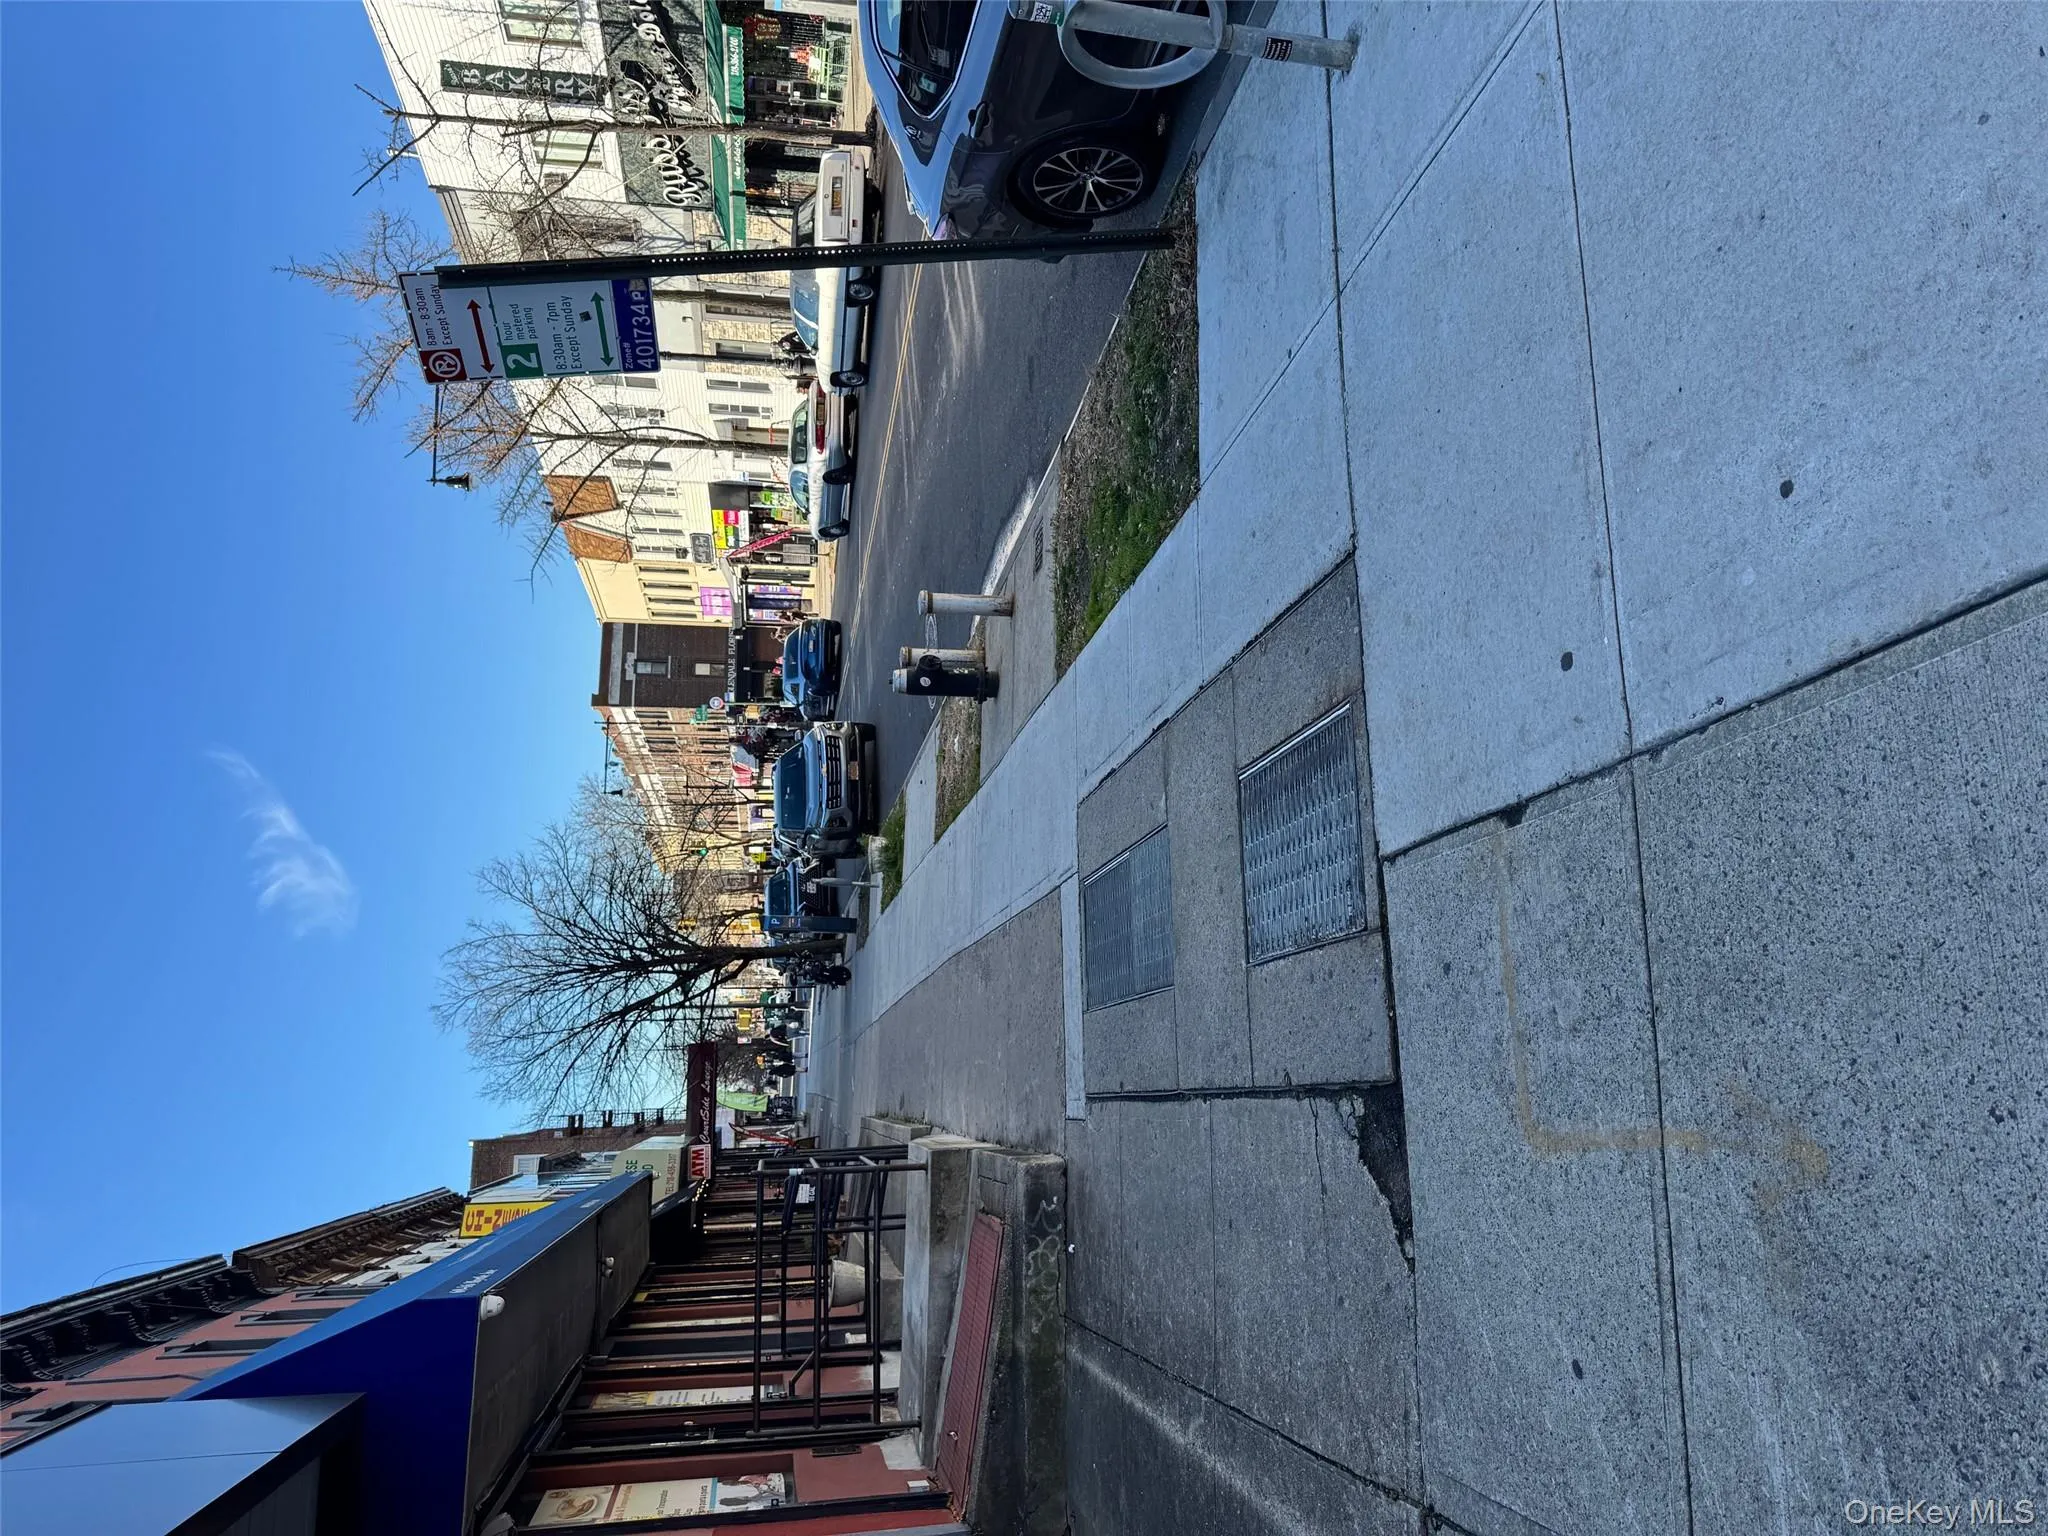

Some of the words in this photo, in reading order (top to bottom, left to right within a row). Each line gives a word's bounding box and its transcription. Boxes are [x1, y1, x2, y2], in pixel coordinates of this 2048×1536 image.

[463, 68, 597, 97] BAKERY
[430, 284, 446, 315] Sunday
[546, 302, 560, 324] 7pm
[560, 296, 576, 332] Sunday
[436, 318, 453, 346] Except
[502, 321, 514, 341] hour
[508, 303, 525, 340] metered
[524, 307, 538, 339] parking
[630, 304, 656, 369] 401734
[426, 328, 437, 346] 8am
[552, 334, 568, 370] 8:30am
[566, 335, 582, 369] Except
[506, 352, 538, 370] 2
[691, 1148, 704, 1177] ATM
